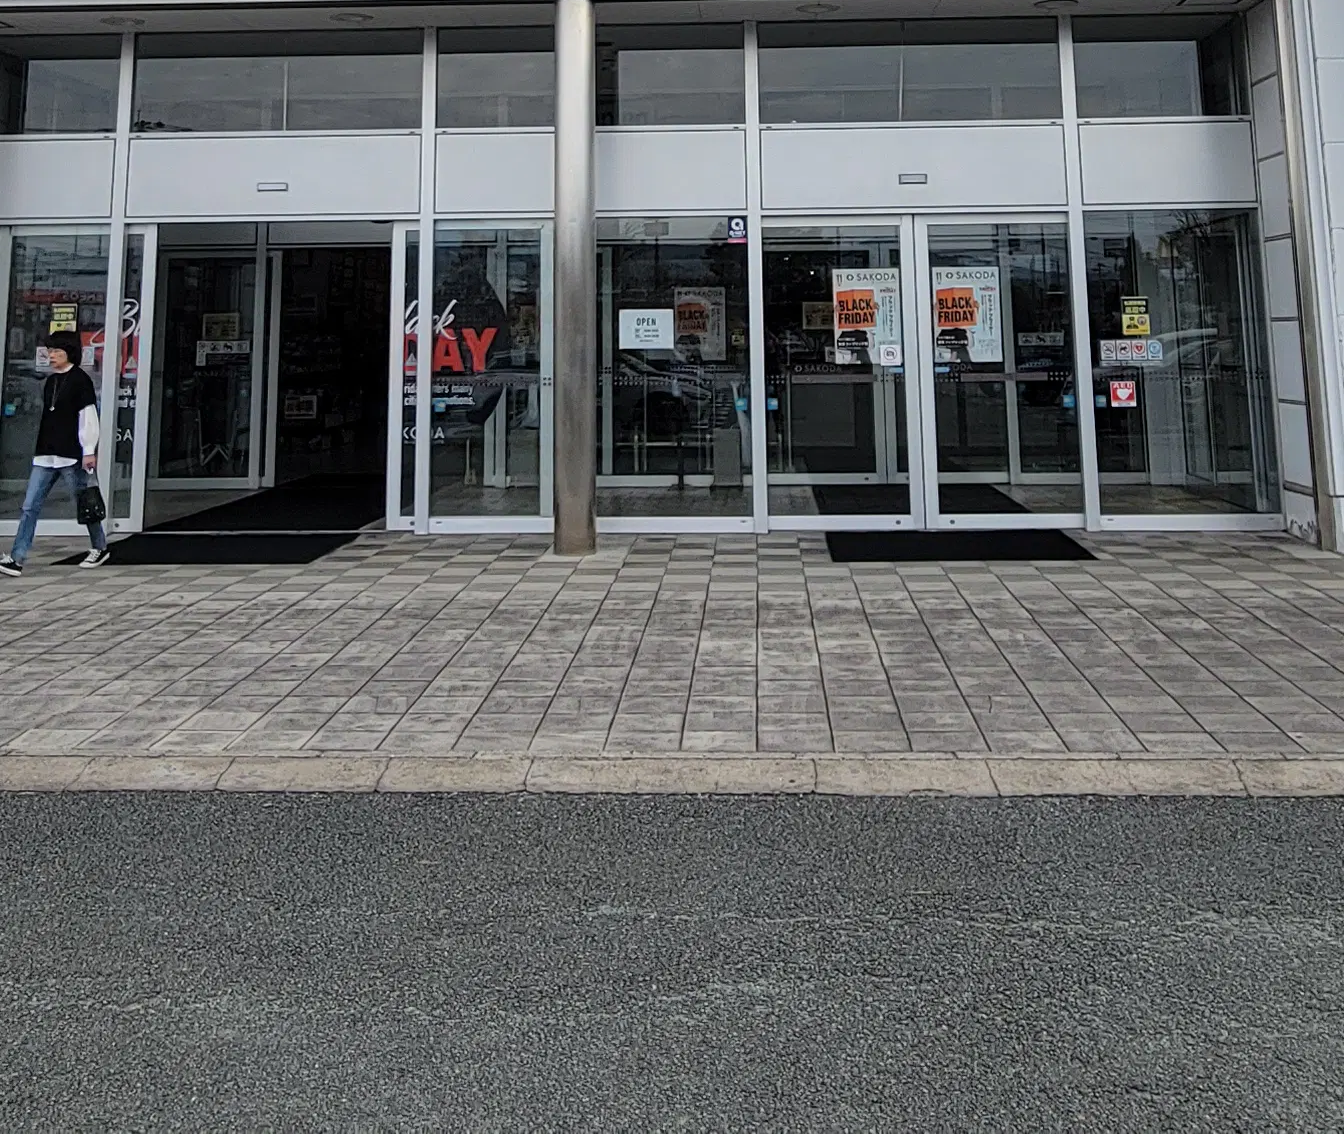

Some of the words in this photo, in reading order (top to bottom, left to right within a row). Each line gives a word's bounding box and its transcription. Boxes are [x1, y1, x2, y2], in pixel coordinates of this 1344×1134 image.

[856, 272, 896, 281] SAKODA
[956, 271, 996, 279] SAKODA
[838, 299, 873, 312] BLACK
[938, 297, 972, 310] BLACK
[636, 317, 657, 327] OPEN
[838, 312, 875, 325] FRIDAY
[938, 310, 974, 323] FRIDAY
